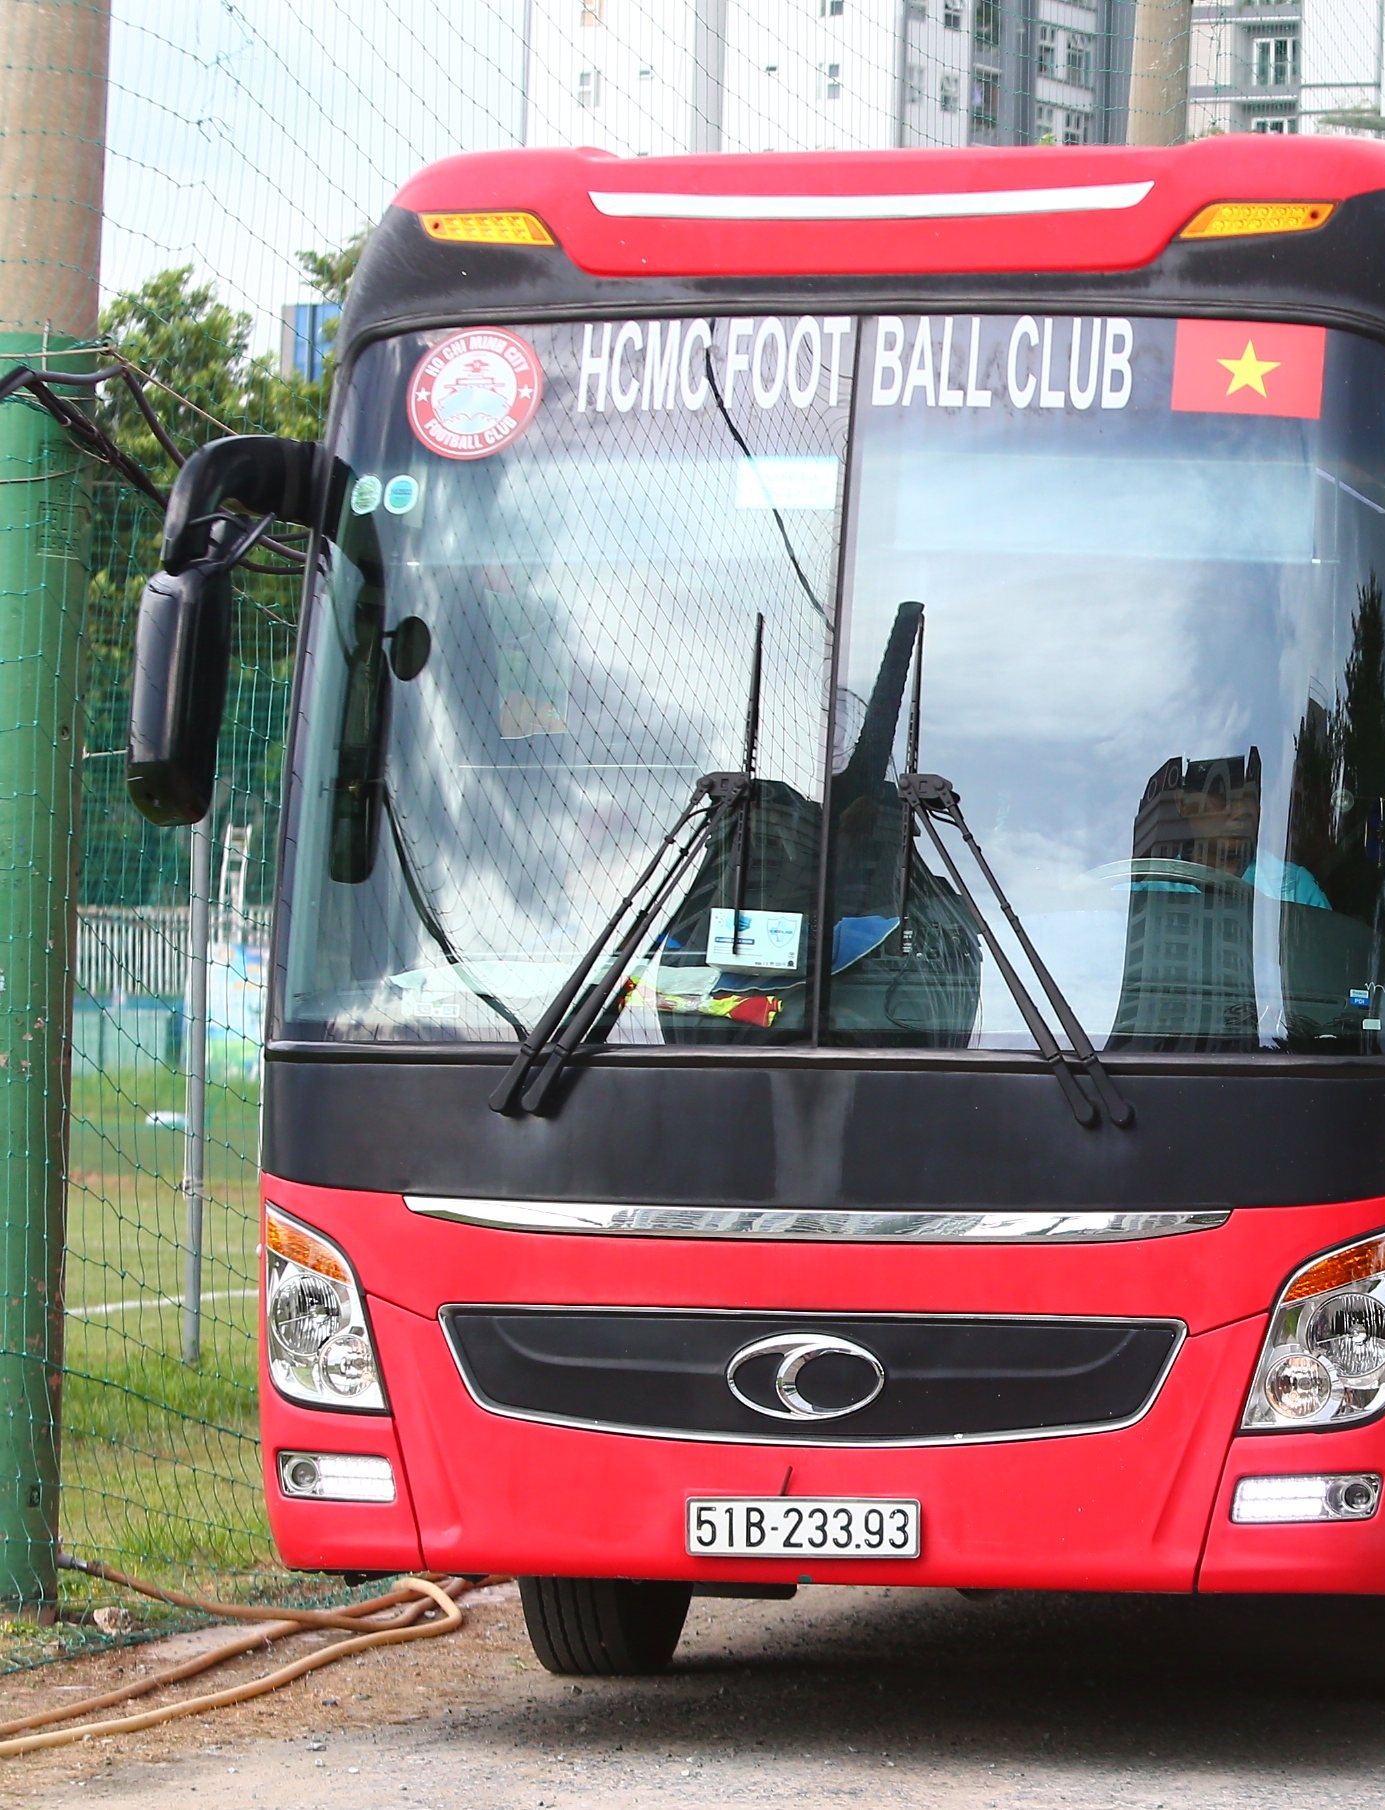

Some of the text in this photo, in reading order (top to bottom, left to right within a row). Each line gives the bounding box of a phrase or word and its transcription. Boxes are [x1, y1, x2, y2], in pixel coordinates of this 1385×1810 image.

[424, 335, 530, 378] HO CHI MINH CITY
[577, 315, 1133, 413] HCMC FOOT BALL CLUB
[424, 415, 518, 450] FOOTBALL CLUB
[696, 1507, 910, 1550] 51B-233.93
